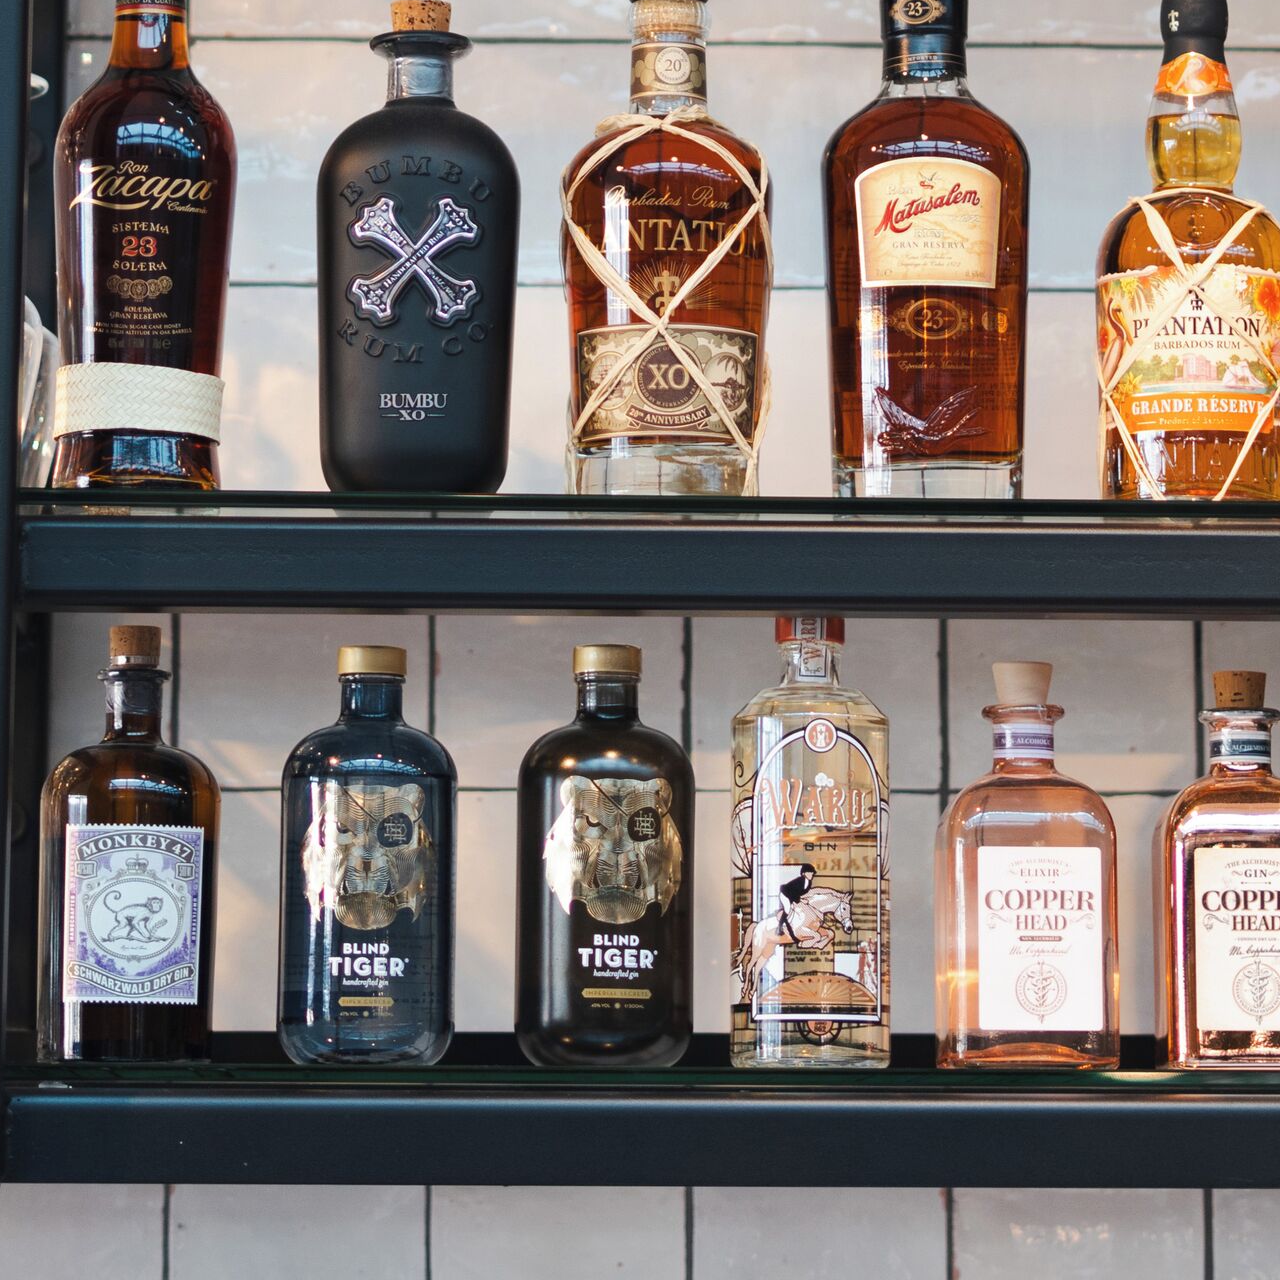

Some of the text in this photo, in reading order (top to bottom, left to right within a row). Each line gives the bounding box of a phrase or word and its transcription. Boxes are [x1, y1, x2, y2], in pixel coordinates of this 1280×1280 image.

[907, 1, 923, 17] 23
[664, 58, 682, 72] 20
[117, 160, 150, 175] Ron
[69, 163, 214, 211] Zacapa
[340, 156, 495, 207] BUMBU
[603, 184, 731, 210] Barbados Rum
[873, 182, 981, 237] Matusalem
[111, 221, 170, 235] SISTEMA
[121, 235, 158, 258] 23
[892, 241, 966, 250] GRAN RESERVA
[112, 259, 168, 272] SOLERA
[921, 309, 945, 329] 23
[337, 319, 424, 364] RUM
[1153, 340, 1241, 350] BARBADOS RUM
[648, 363, 690, 391] XO
[379, 393, 449, 409] BUMBU
[1132, 398, 1193, 416] GRANDE
[398, 409, 426, 421] XO
[644, 408, 708, 426] ANNIVERSARY
[81, 833, 192, 858] MONKEY 47
[804, 842, 837, 852] GIN
[1020, 868, 1060, 877] ELIXIR
[1226, 860, 1241, 869] THE
[1243, 868, 1269, 878] GIN
[984, 889, 1095, 912] COPPER
[1016, 914, 1068, 931] HEAD
[593, 933, 640, 947] BLIND
[342, 942, 390, 955] BLIND
[73, 965, 190, 994] SCHWARZWALD DRY GIN
[593, 969, 639, 980] handcrafted gin
[342, 977, 389, 989] handcrafted gin
